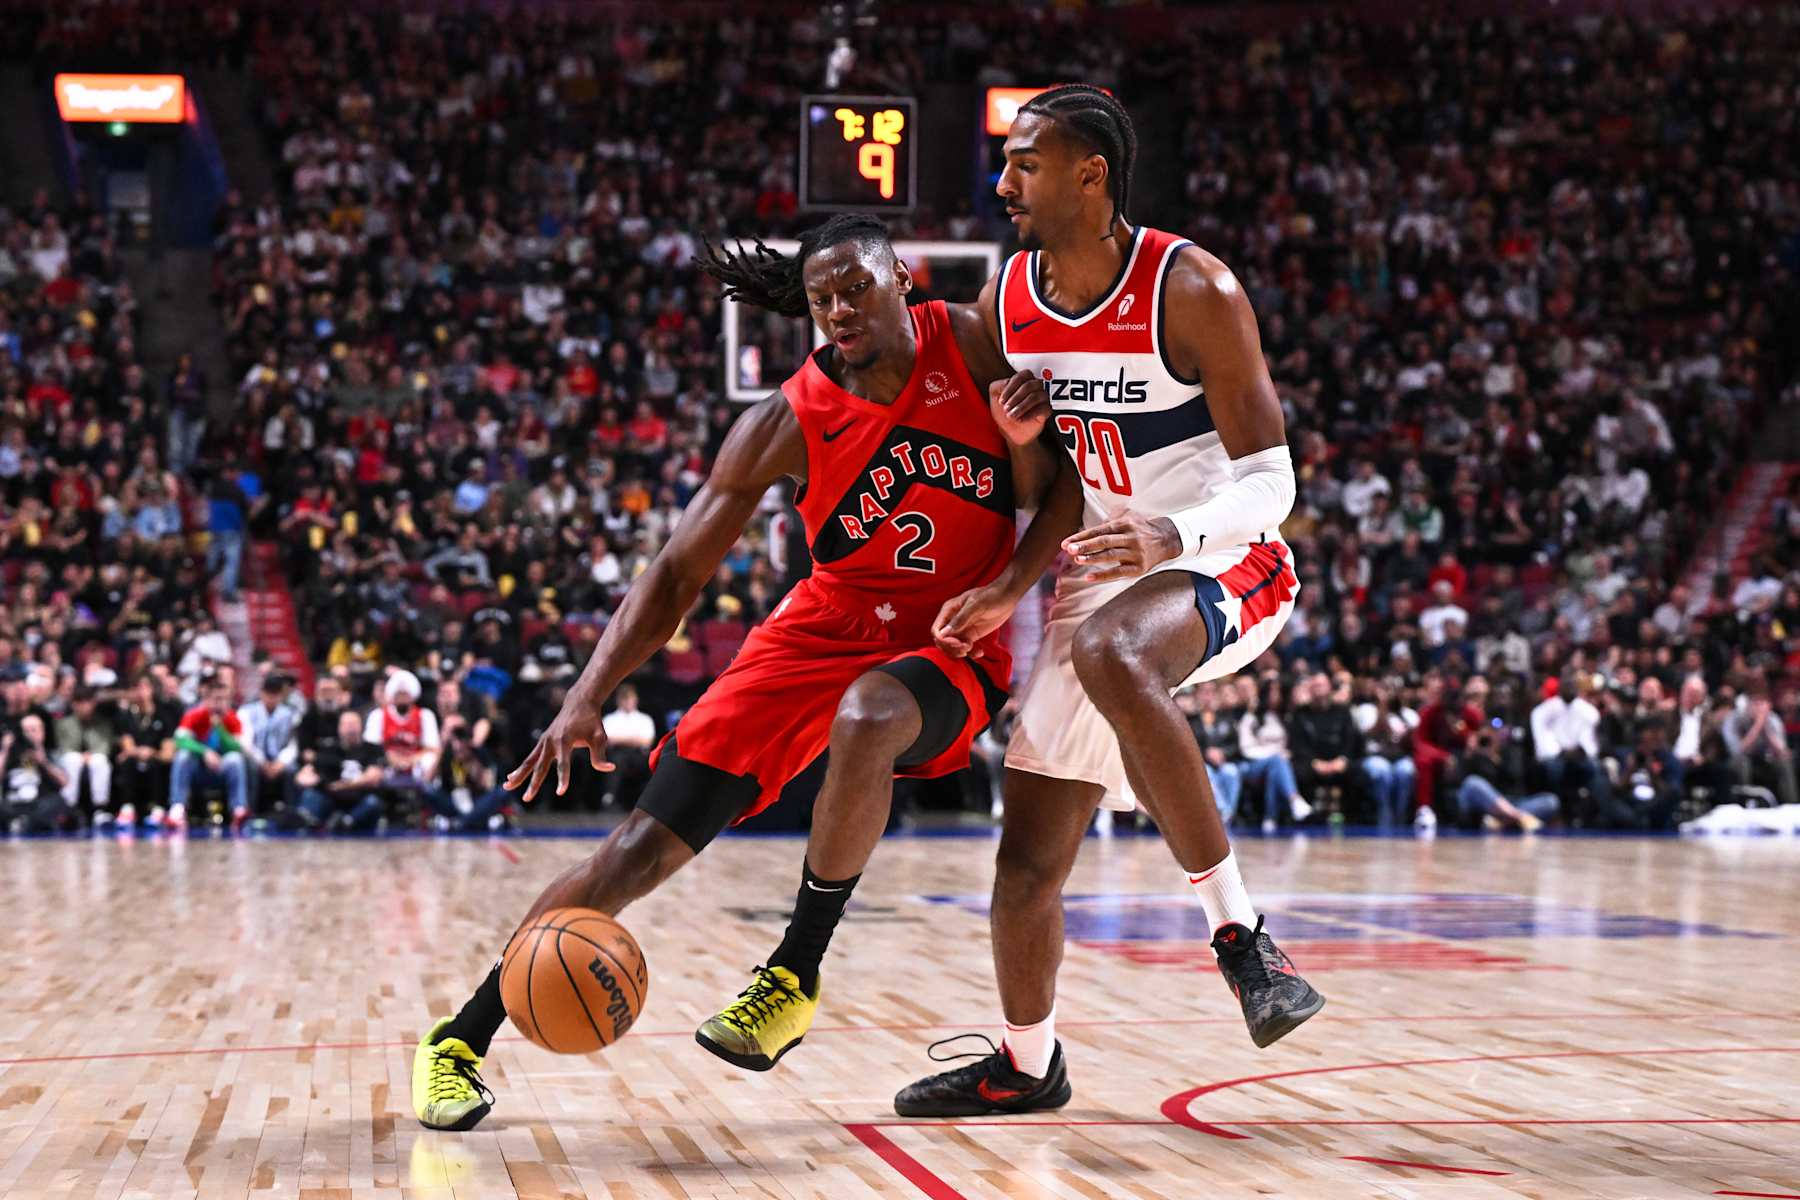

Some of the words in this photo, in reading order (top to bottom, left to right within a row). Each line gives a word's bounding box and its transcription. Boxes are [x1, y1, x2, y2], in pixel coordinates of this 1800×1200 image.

[859, 143, 894, 199] 9
[1107, 322, 1147, 332] Robinhood
[925, 397, 944, 408] Sun
[942, 389, 960, 401] Life
[1041, 367, 1150, 404] izards
[1055, 415, 1133, 496] 20
[839, 441, 994, 539] RAPTORS
[891, 511, 936, 574] 2
